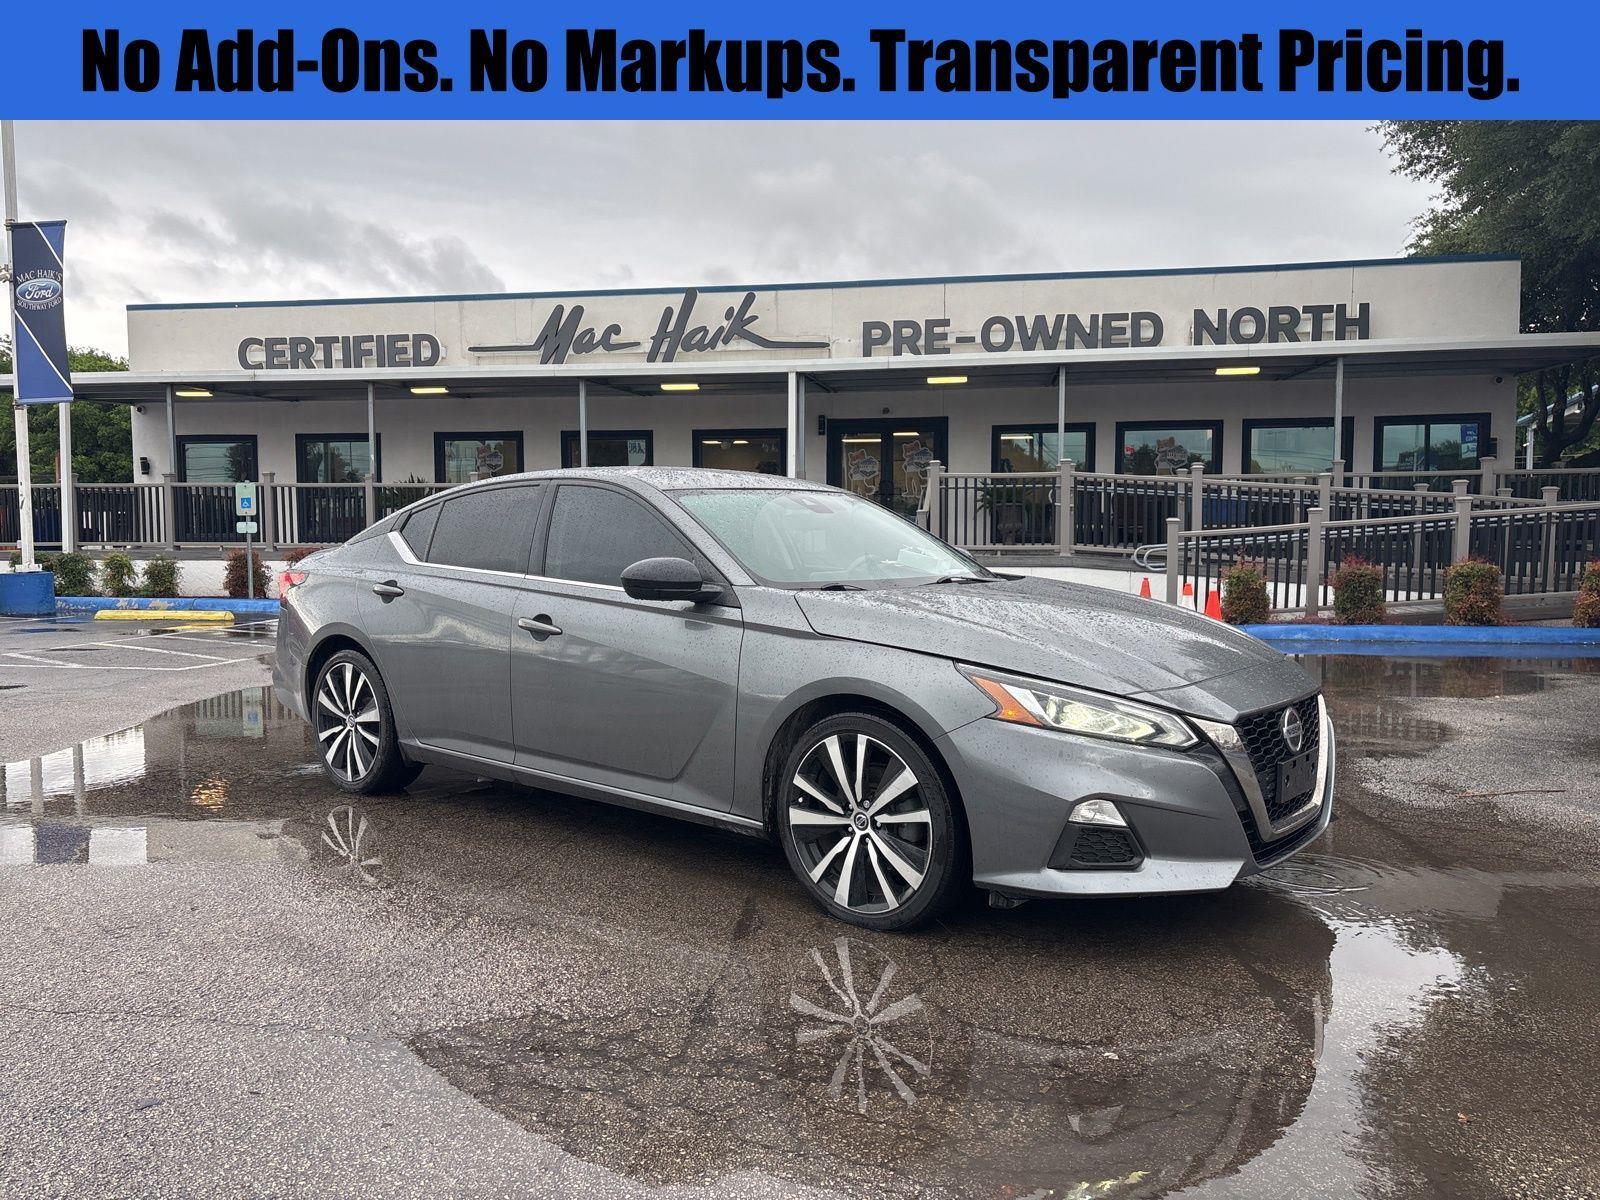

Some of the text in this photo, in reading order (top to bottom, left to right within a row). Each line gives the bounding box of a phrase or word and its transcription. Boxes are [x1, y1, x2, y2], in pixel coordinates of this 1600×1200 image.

[16, 269, 63, 284] MAC HAIK'S
[16, 296, 62, 310] SOUTHWAY FORD
[25, 282, 54, 300] Ford
[468, 287, 831, 365] Mac Haik
[862, 302, 1370, 358] PRE-OWNED NORTH
[238, 334, 441, 368] CERTIFIED
